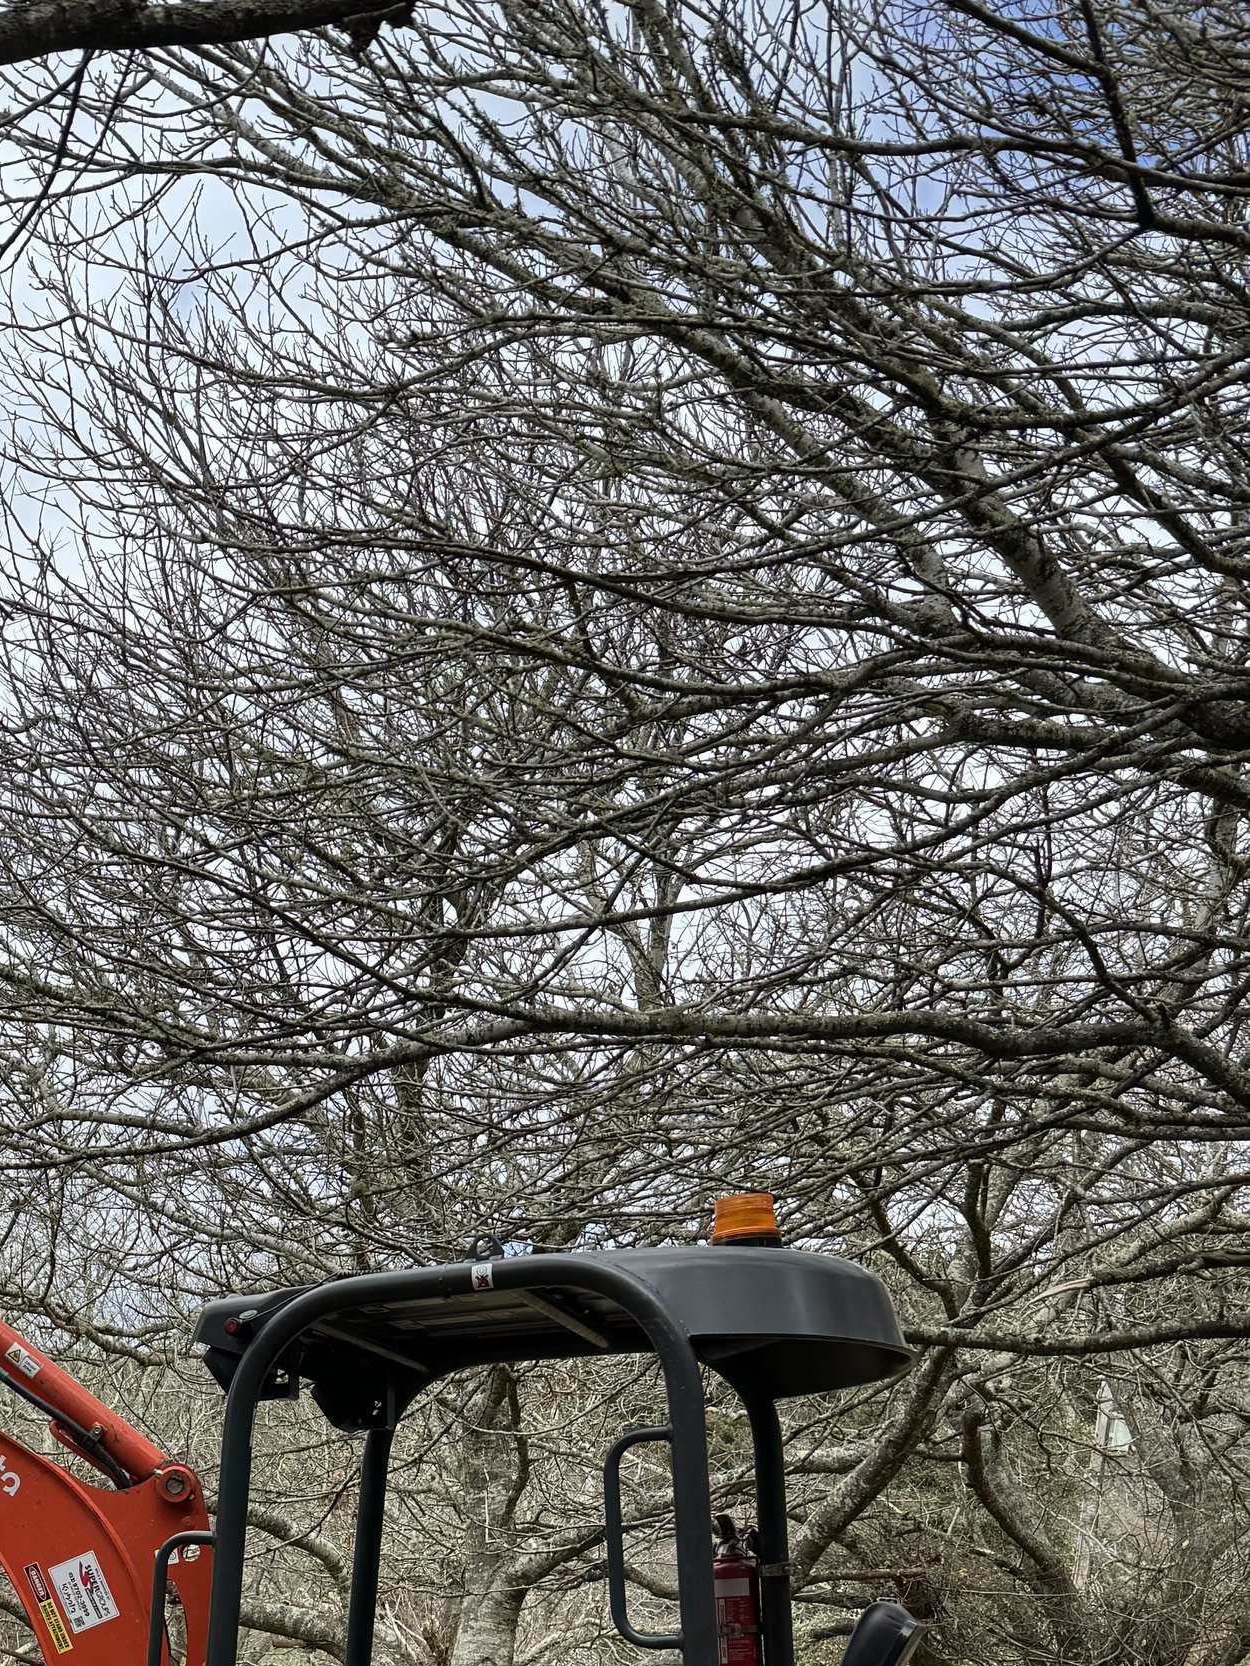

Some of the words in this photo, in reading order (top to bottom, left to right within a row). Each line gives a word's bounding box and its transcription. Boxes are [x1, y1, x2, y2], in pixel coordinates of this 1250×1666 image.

[30, 1570, 45, 1596] DANGER
[61, 1583, 77, 1613] Kubota
[84, 1564, 111, 1617] SUPERGROUPS
